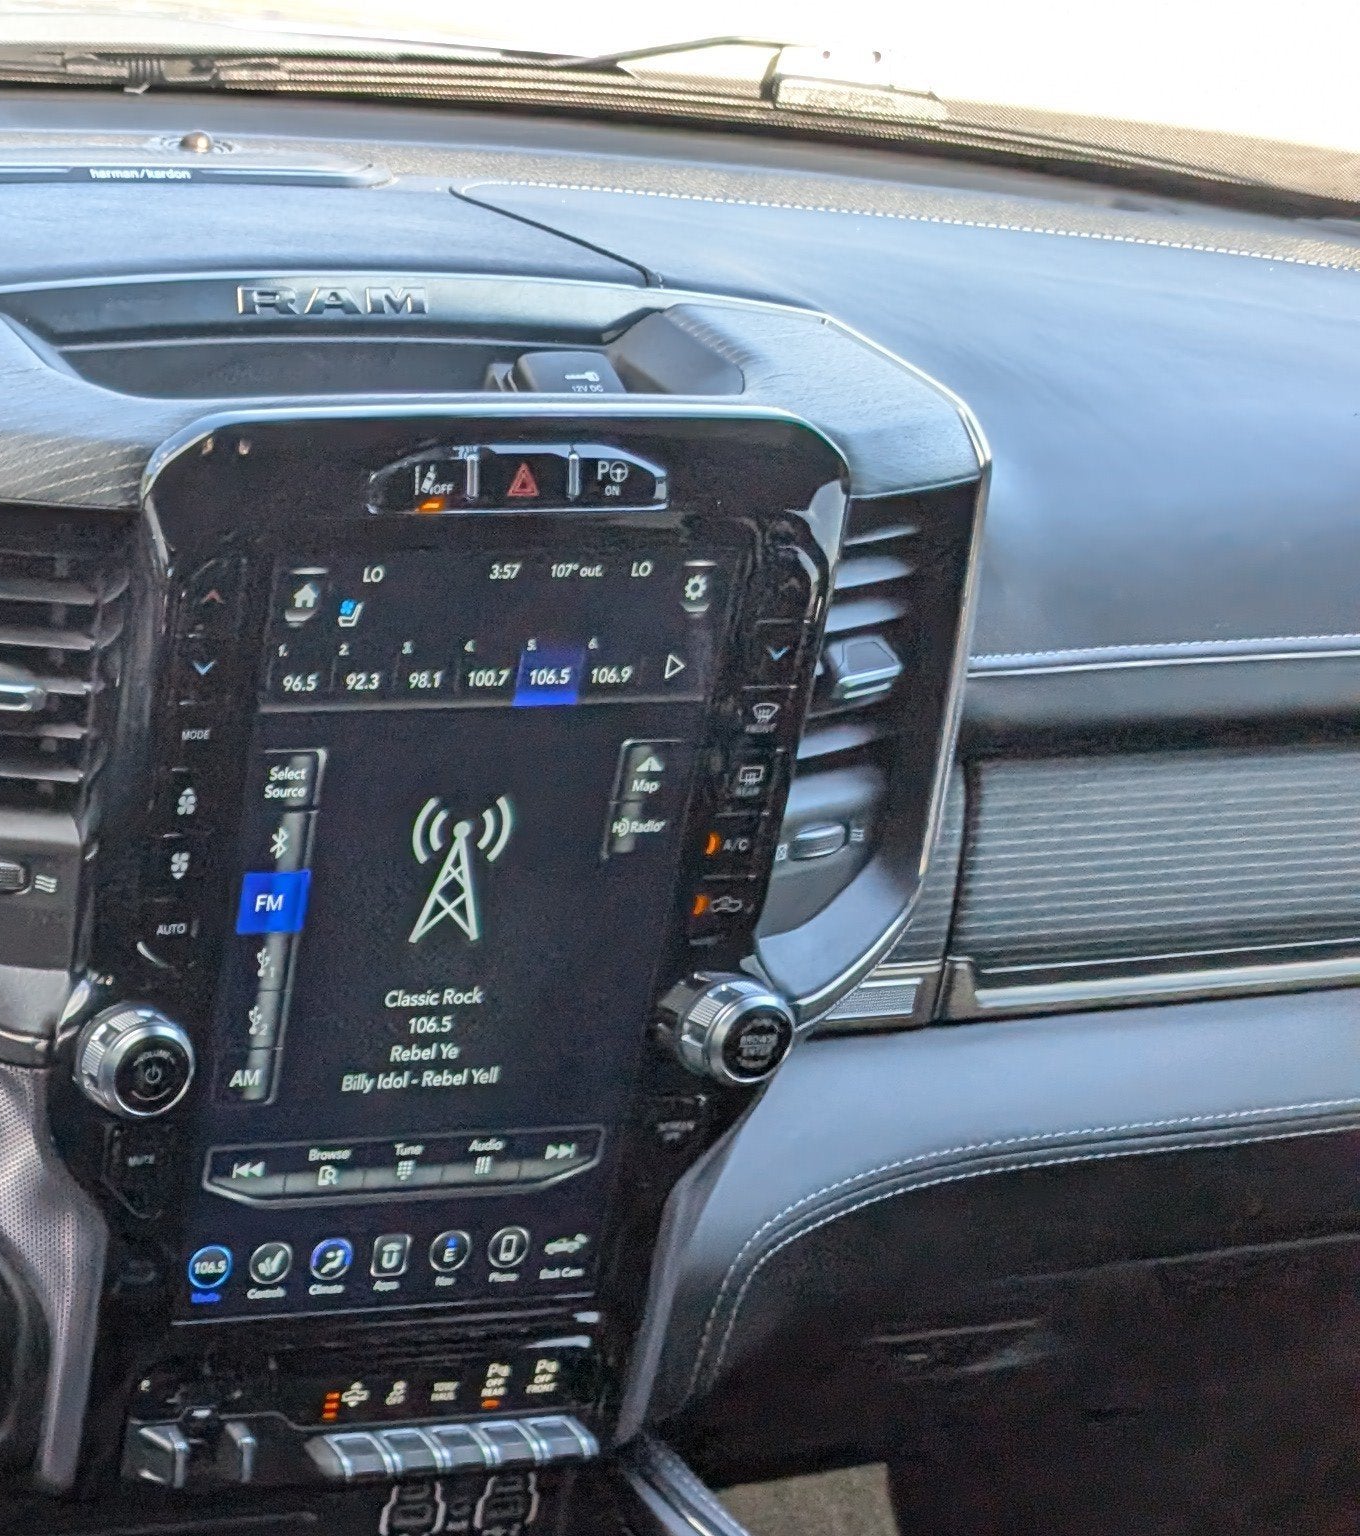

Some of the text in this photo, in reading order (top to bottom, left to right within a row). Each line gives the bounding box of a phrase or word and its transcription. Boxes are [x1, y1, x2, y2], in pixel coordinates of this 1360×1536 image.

[236, 285, 429, 315] RAM
[597, 461, 610, 480] P
[434, 483, 454, 495] OFF
[604, 484, 621, 496] ON
[363, 565, 385, 583] LO
[489, 563, 522, 580] 3:57
[631, 560, 653, 577] LO
[282, 672, 319, 691] 96.5
[345, 672, 380, 690] 92.3
[409, 670, 443, 689] 98.1
[468, 668, 511, 686] 100.7
[530, 667, 571, 685] 106.5
[591, 665, 632, 684] 106.9
[182, 729, 210, 740] MODE
[269, 766, 306, 781] Select
[264, 785, 306, 799] Source
[632, 779, 659, 794] Map
[723, 838, 749, 851] A/C
[254, 894, 284, 913] FM
[156, 923, 186, 936] AUTO
[384, 986, 483, 1008] Classic Rock
[408, 1015, 453, 1034] 106.5
[390, 1043, 460, 1062] Rebel Ye
[229, 1069, 261, 1088] AM
[341, 1073, 374, 1093] Billy
[377, 1071, 410, 1090] Idol
[421, 1069, 468, 1087] Rebel
[472, 1065, 501, 1084] Yell
[394, 1143, 425, 1156] Tune
[468, 1138, 506, 1152] Audio
[308, 1149, 353, 1161] Browse
